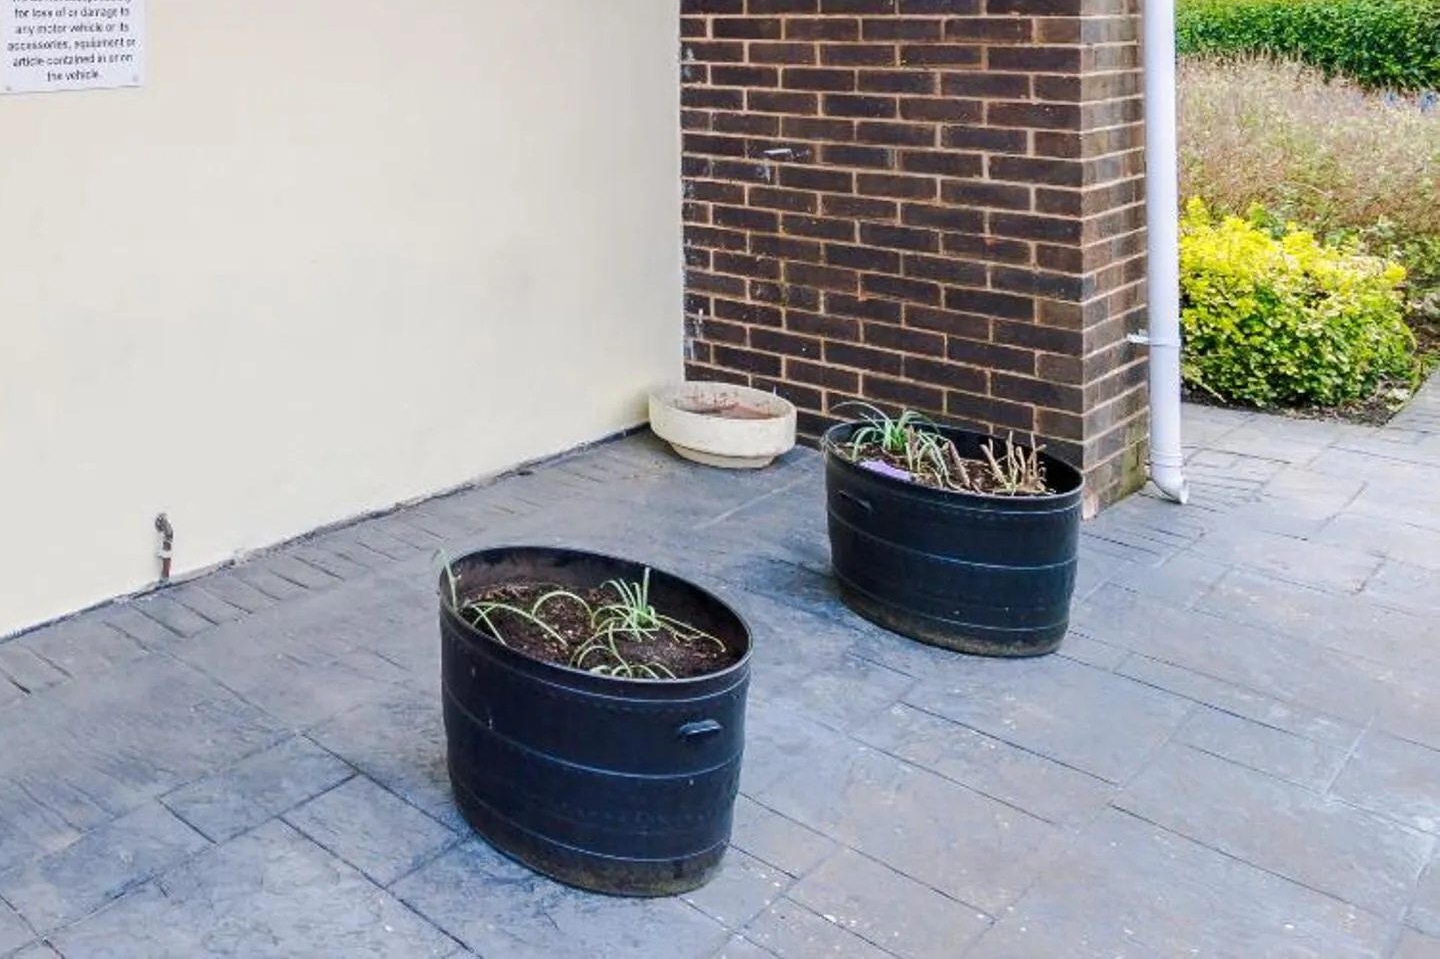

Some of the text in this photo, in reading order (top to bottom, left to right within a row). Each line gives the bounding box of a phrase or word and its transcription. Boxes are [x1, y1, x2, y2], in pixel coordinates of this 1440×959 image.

[15, 8, 29, 19] for
[32, 8, 52, 17] loss
[80, 7, 117, 19] damage
[121, 7, 129, 16] to
[15, 25, 34, 35] any
[37, 24, 66, 34] motor
[70, 23, 102, 33] vehicle
[105, 24, 116, 32] or
[7, 38, 136, 51] accessories, equipment or
[13, 57, 44, 67] article
[47, 55, 94, 65] contained
[47, 71, 62, 82] the
